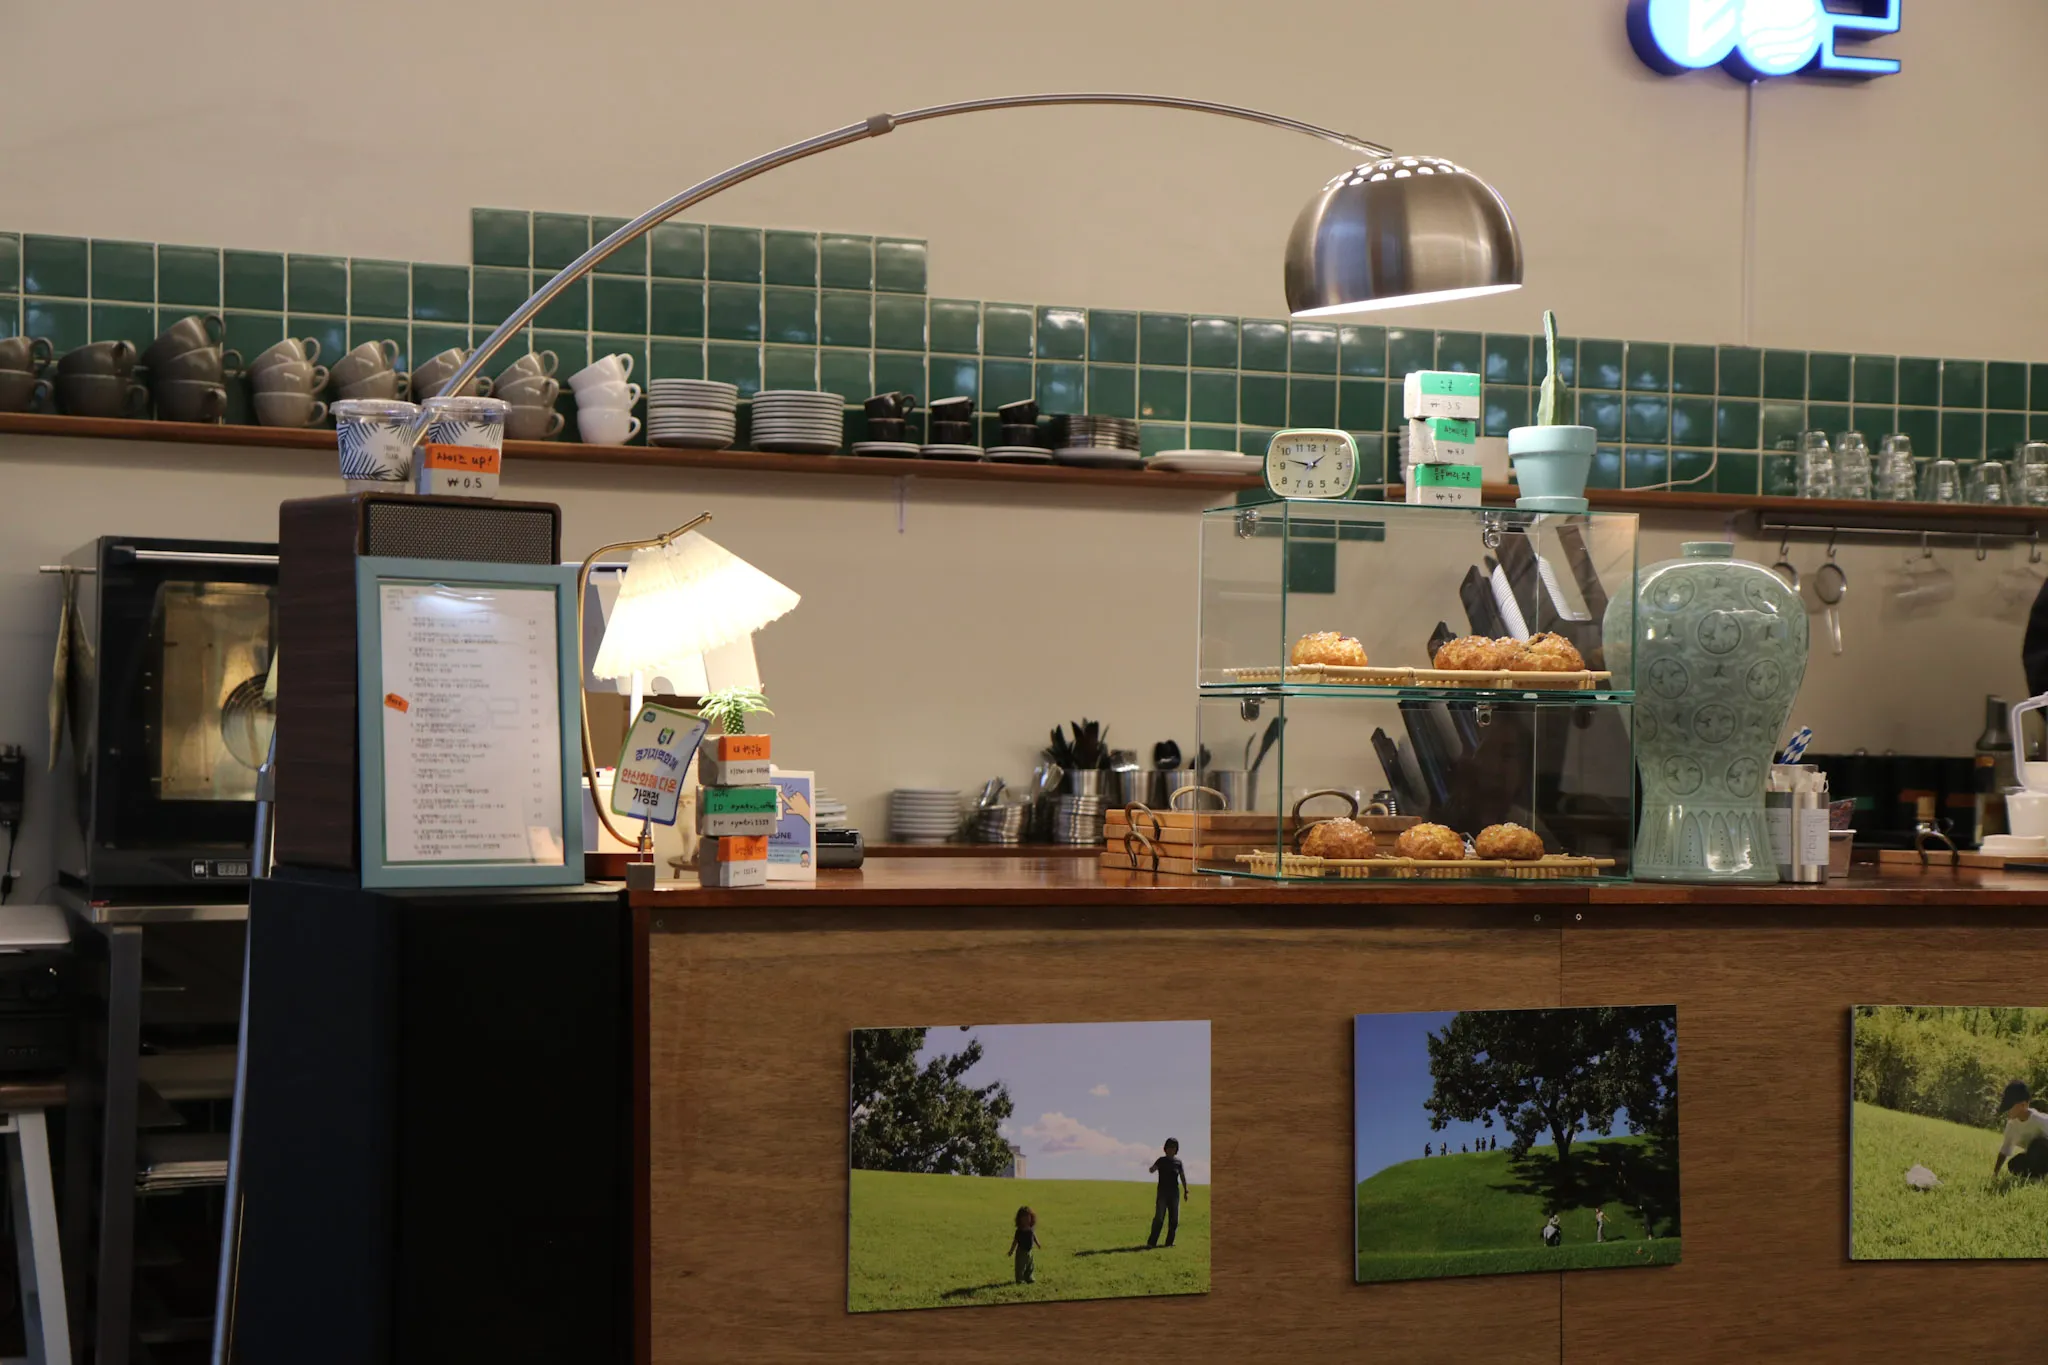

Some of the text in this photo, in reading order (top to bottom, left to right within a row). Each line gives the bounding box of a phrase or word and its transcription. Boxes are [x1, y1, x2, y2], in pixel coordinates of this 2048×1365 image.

[1281, 447, 1291, 456] 10
[1296, 444, 1303, 452] 11
[1307, 444, 1317, 452] 12
[1322, 444, 1326, 452] 1
[1334, 447, 1341, 456] 2
[436, 451, 468, 465] 사이즈
[1280, 461, 1286, 470] 9
[1336, 462, 1343, 470] 3
[1281, 476, 1288, 485] 8
[1296, 480, 1301, 488] 7
[1307, 480, 1314, 488] 6
[1320, 480, 1326, 488] 5
[1334, 477, 1340, 485] 4
[621, 768, 678, 793] 안산화폐 다온
[632, 788, 660, 806] 가맹점
